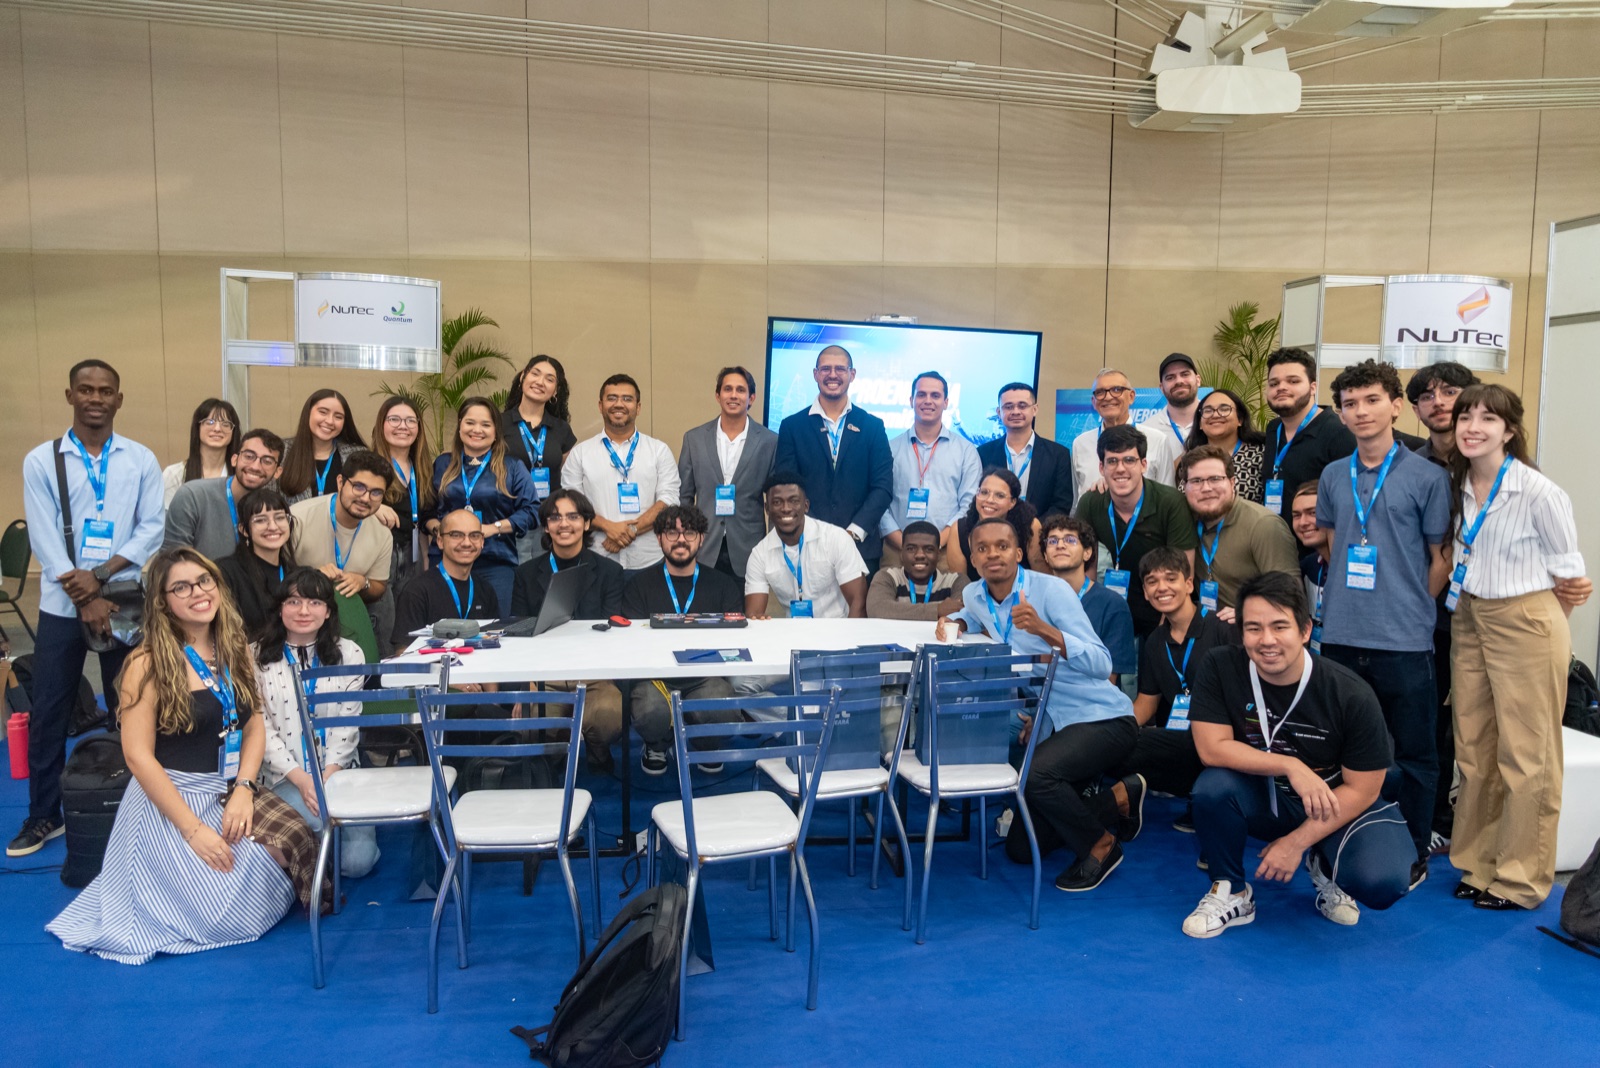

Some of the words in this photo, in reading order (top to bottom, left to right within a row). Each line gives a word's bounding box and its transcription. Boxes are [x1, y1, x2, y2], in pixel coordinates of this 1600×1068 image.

[331, 305, 374, 315] NuTec
[383, 315, 412, 323] Quantum
[1397, 327, 1503, 347] NuTec
